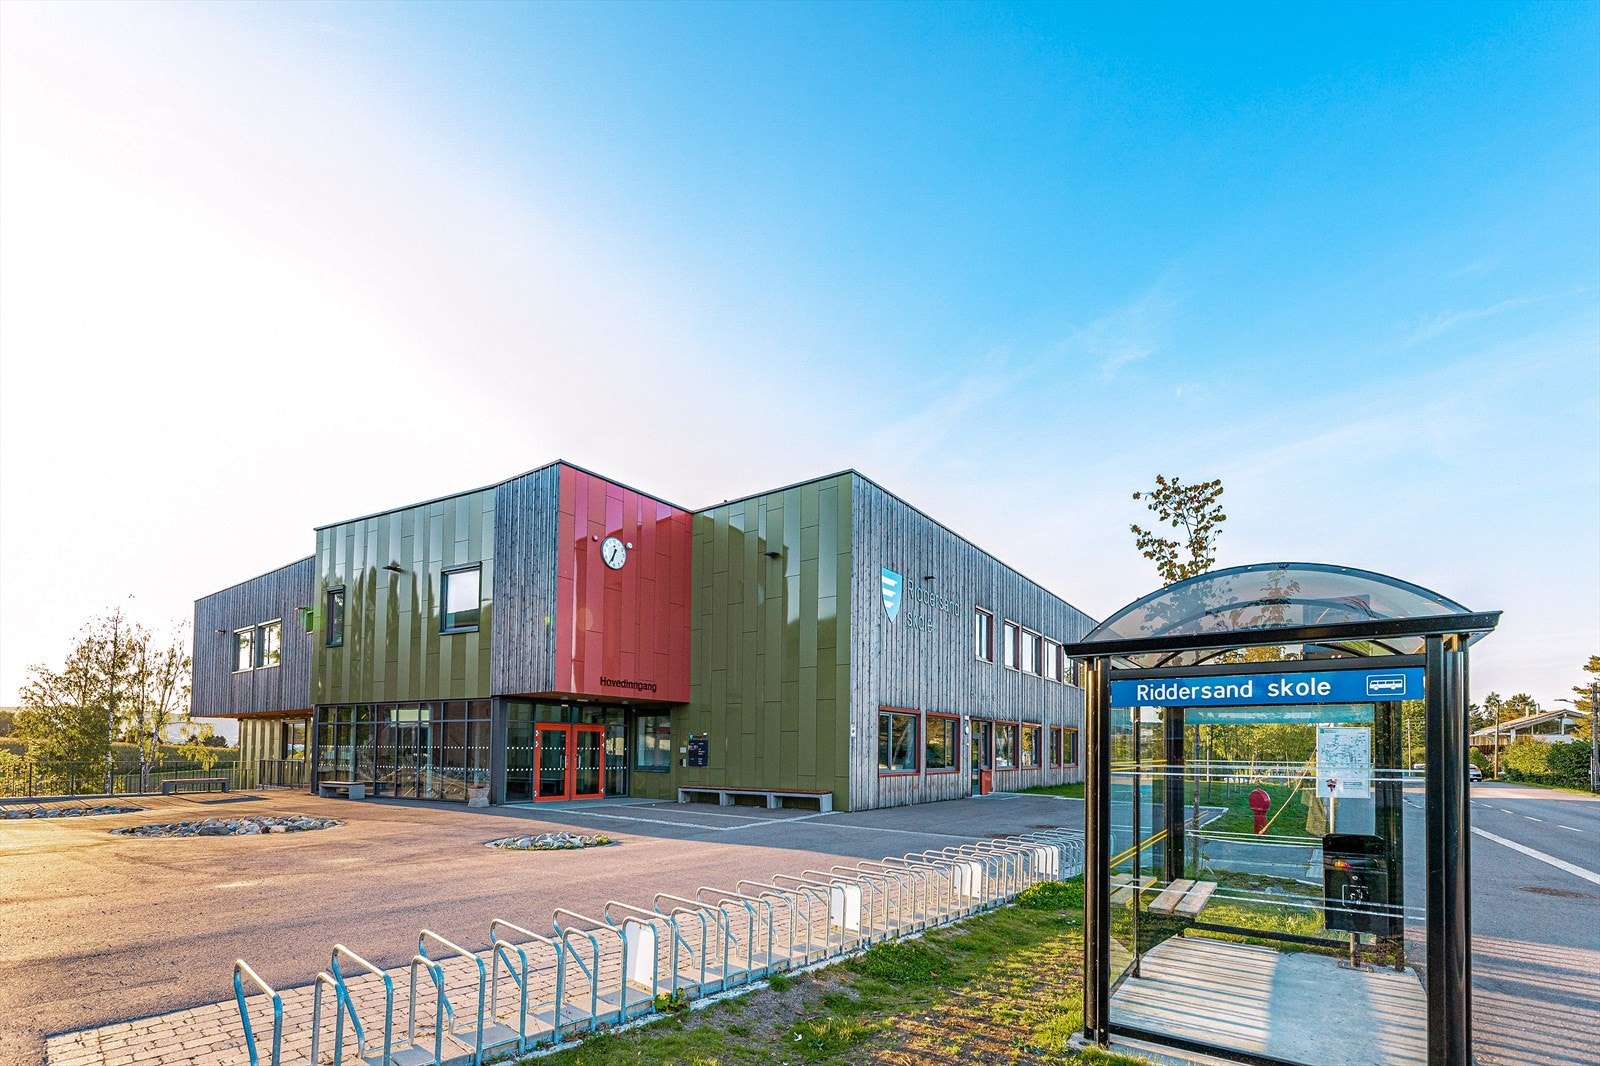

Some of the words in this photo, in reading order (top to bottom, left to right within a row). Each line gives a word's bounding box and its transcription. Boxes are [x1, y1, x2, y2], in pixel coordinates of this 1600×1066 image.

[907, 611, 933, 633] skole
[600, 676, 657, 693] Hovedinngang
[1136, 680, 1253, 702] Riddersand
[1267, 677, 1331, 697] skole
